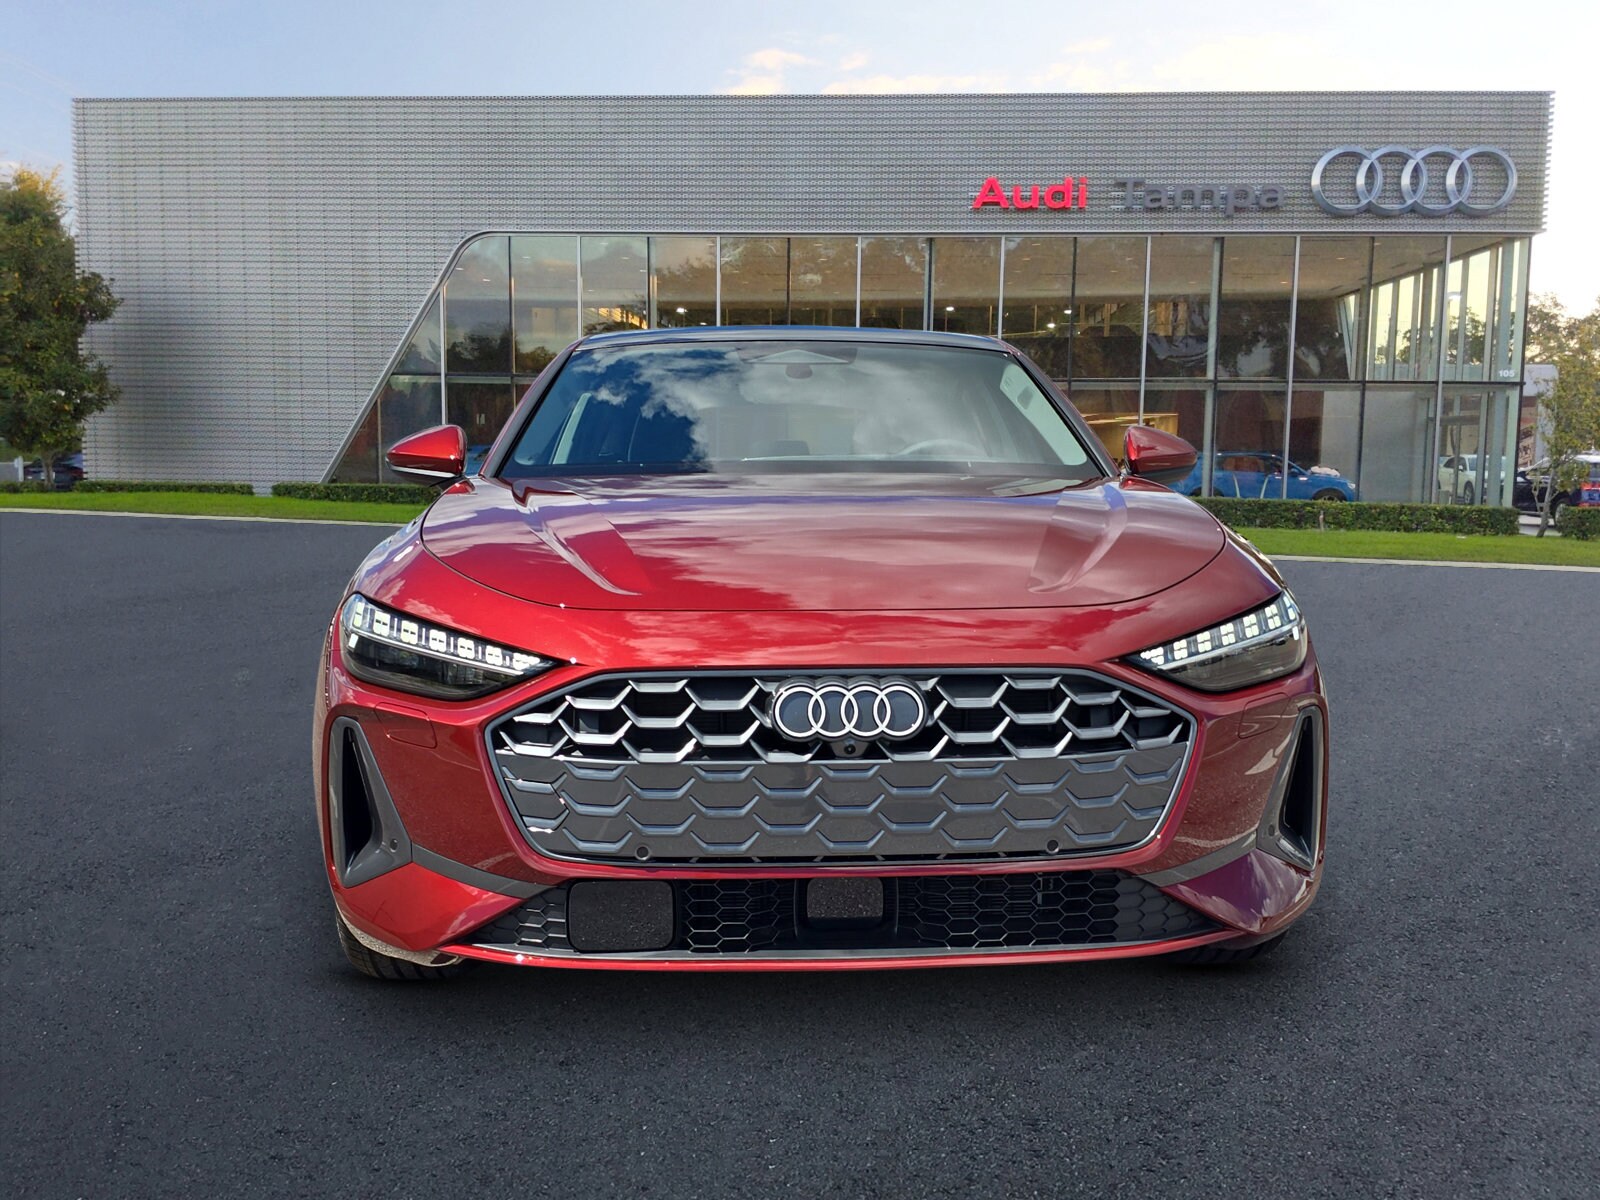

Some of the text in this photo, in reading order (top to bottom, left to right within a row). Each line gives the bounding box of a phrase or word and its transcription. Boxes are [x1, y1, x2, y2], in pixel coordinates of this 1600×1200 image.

[972, 176, 1285, 217] Audi Tampa
[1498, 369, 1515, 378] 105
